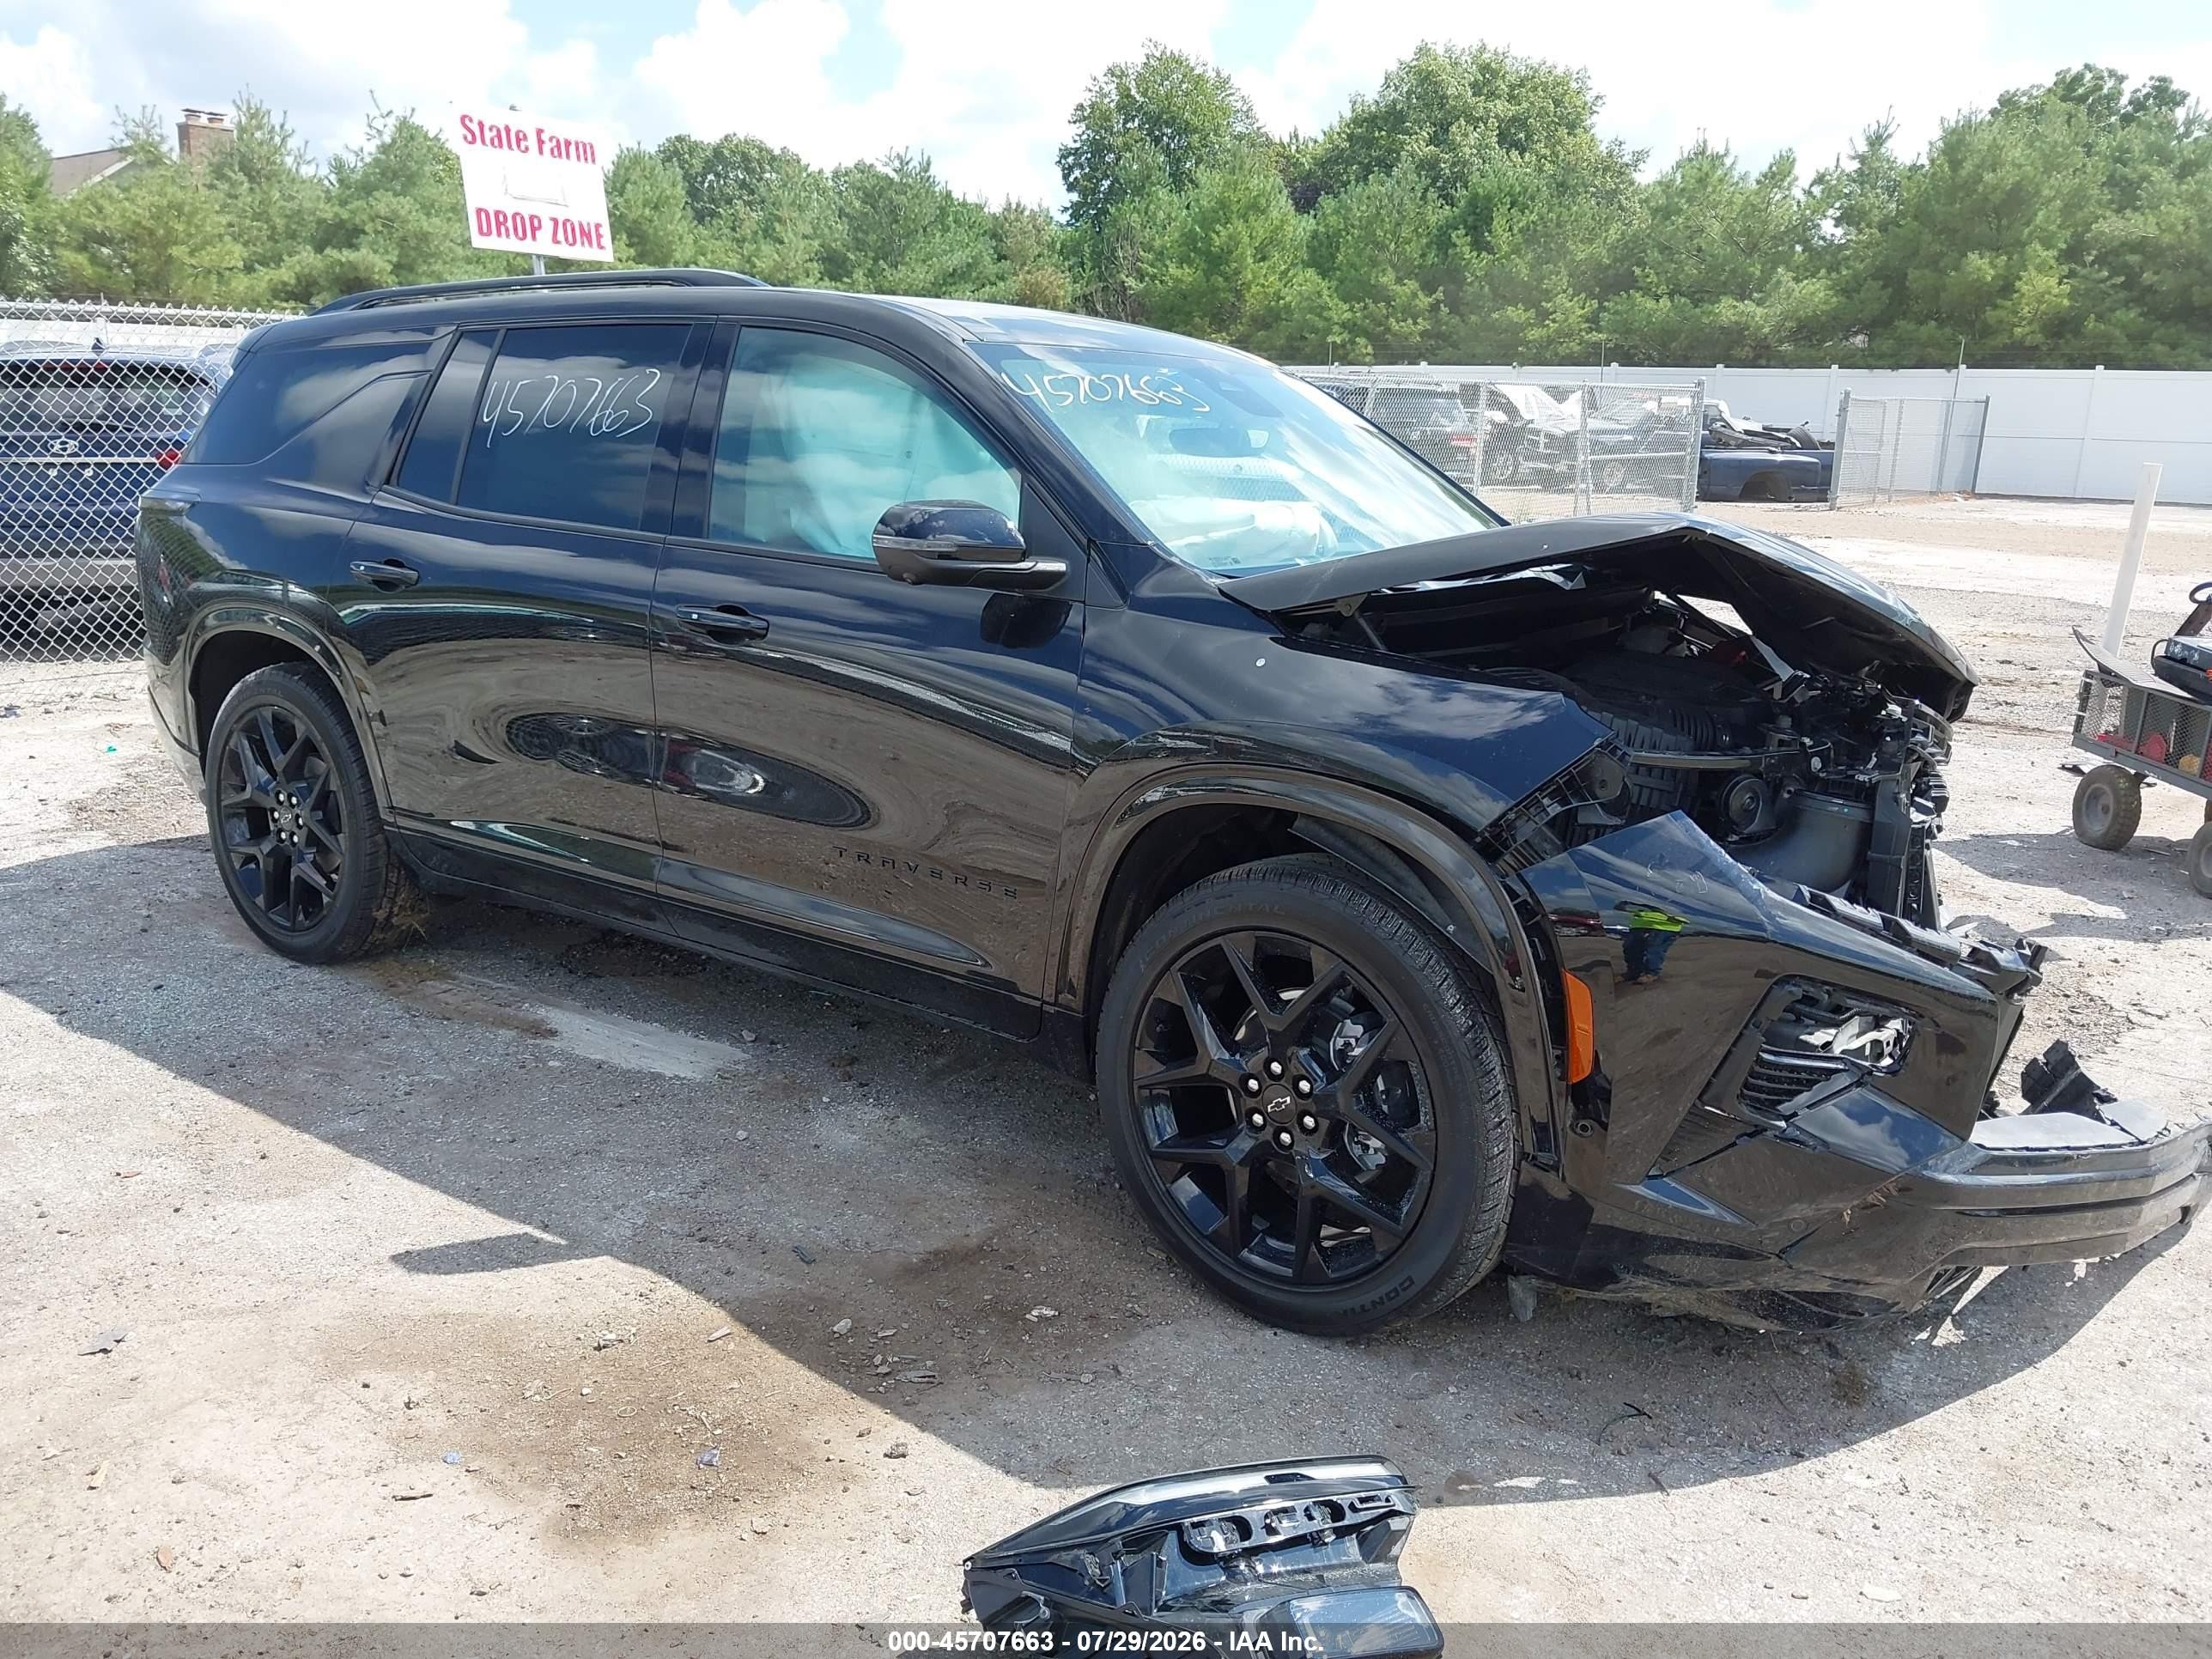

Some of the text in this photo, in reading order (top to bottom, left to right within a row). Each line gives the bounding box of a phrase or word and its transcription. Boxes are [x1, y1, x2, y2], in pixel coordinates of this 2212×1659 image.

[460, 114, 597, 165] State Farm
[475, 207, 606, 250] DROP ZONE
[483, 368, 661, 448] 45707663
[832, 846, 1018, 899] TRAVERSE
